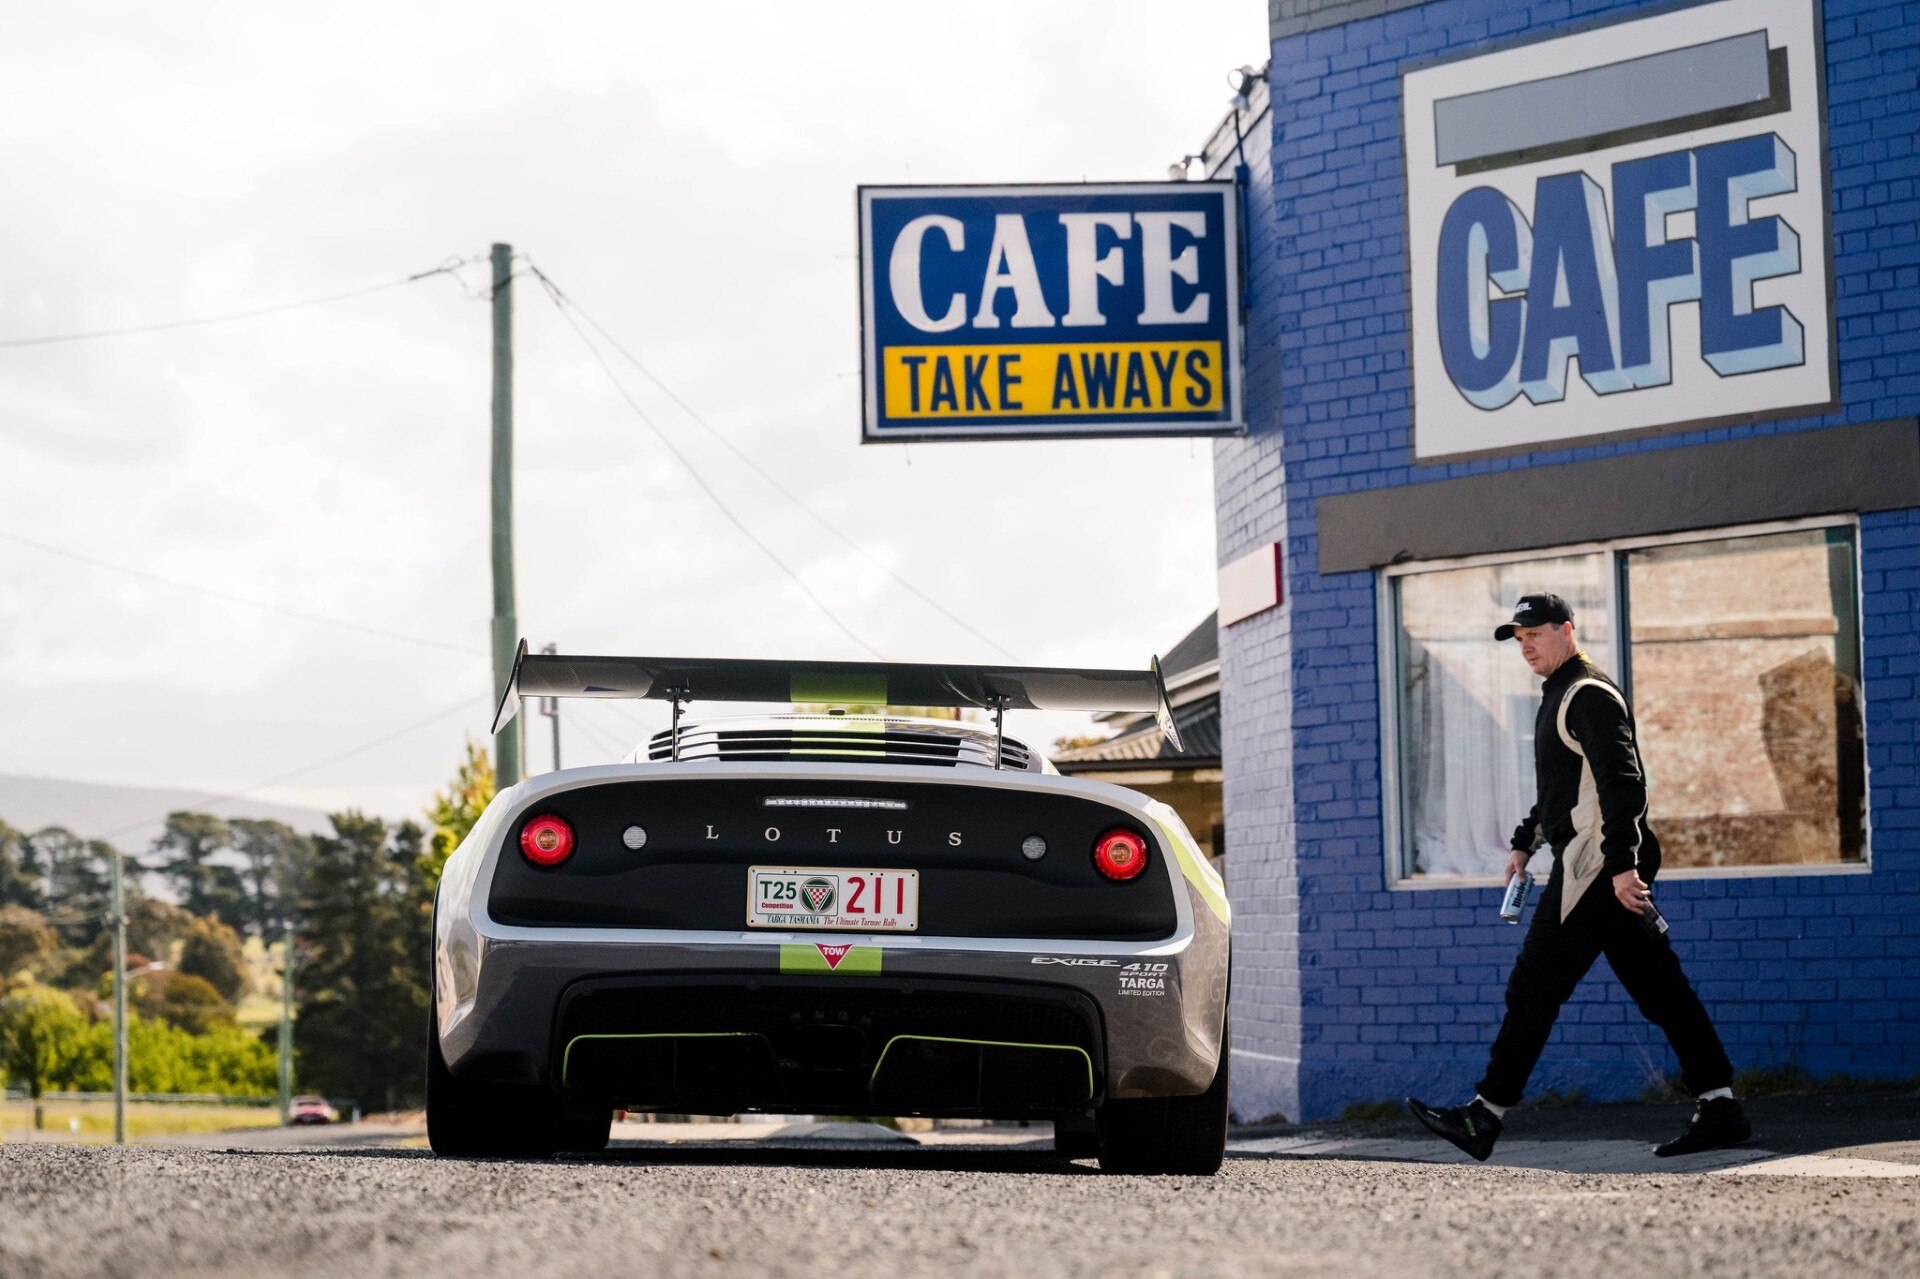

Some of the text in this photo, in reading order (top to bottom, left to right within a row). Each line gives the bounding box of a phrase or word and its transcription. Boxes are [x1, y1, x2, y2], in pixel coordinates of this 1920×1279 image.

[889, 211, 1210, 333] CAFE
[1437, 131, 1805, 411] CAFE
[901, 349, 1213, 412] TAKE AWAYS
[705, 825, 963, 846] LOTUS
[759, 881, 797, 900] T25
[846, 876, 904, 914] 211
[767, 914, 787, 924] TARGA
[824, 916, 897, 929] The Ultimate Tarmac Rally
[823, 946, 844, 955] TOW
[1031, 957, 1169, 972] EXIGE 410
[1119, 977, 1165, 989] TARGA
[1118, 989, 1165, 998] LIMITED EDITION
